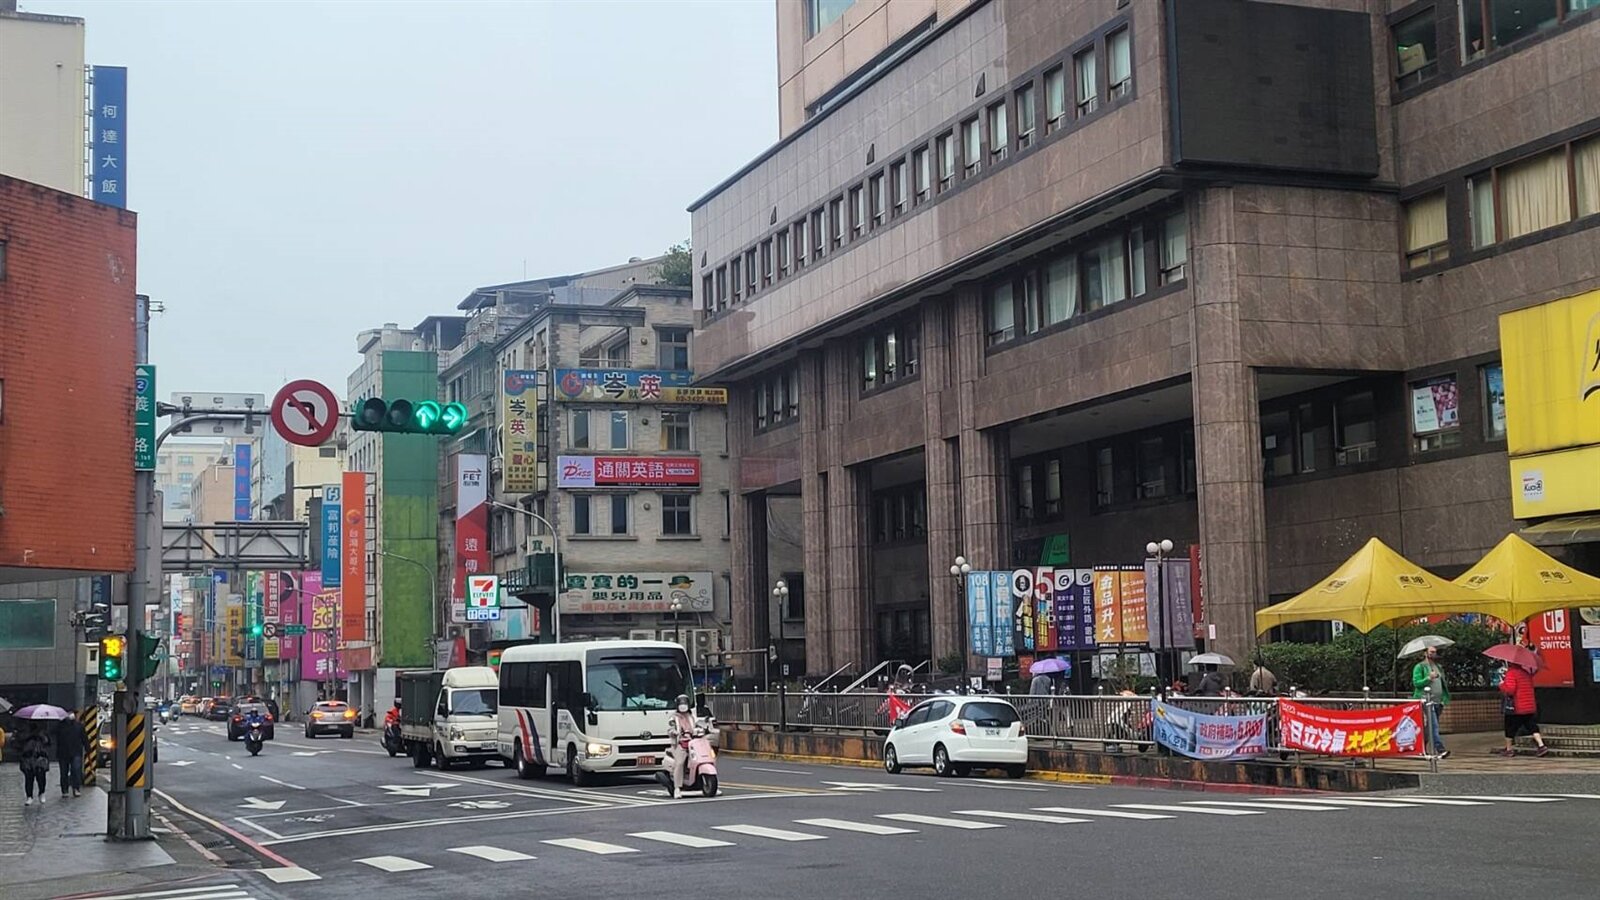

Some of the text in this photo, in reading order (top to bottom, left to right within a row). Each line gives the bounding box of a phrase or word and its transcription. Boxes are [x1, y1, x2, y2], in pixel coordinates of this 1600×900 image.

[102, 105, 118, 194] 柯達大飯
[137, 381, 144, 389] 2
[463, 473, 480, 481] FET
[598, 461, 664, 479] 通關英語
[327, 509, 339, 559] 富邦產險
[465, 537, 478, 573] 遠傳
[592, 591, 664, 601] 嬰兒用品
[1100, 574, 1115, 640] 金品升大
[314, 611, 333, 627] 5G
[1540, 641, 1571, 650] SWITCH
[1199, 722, 1234, 741] 政府補助
[1290, 718, 1347, 753] 日立冷氣
